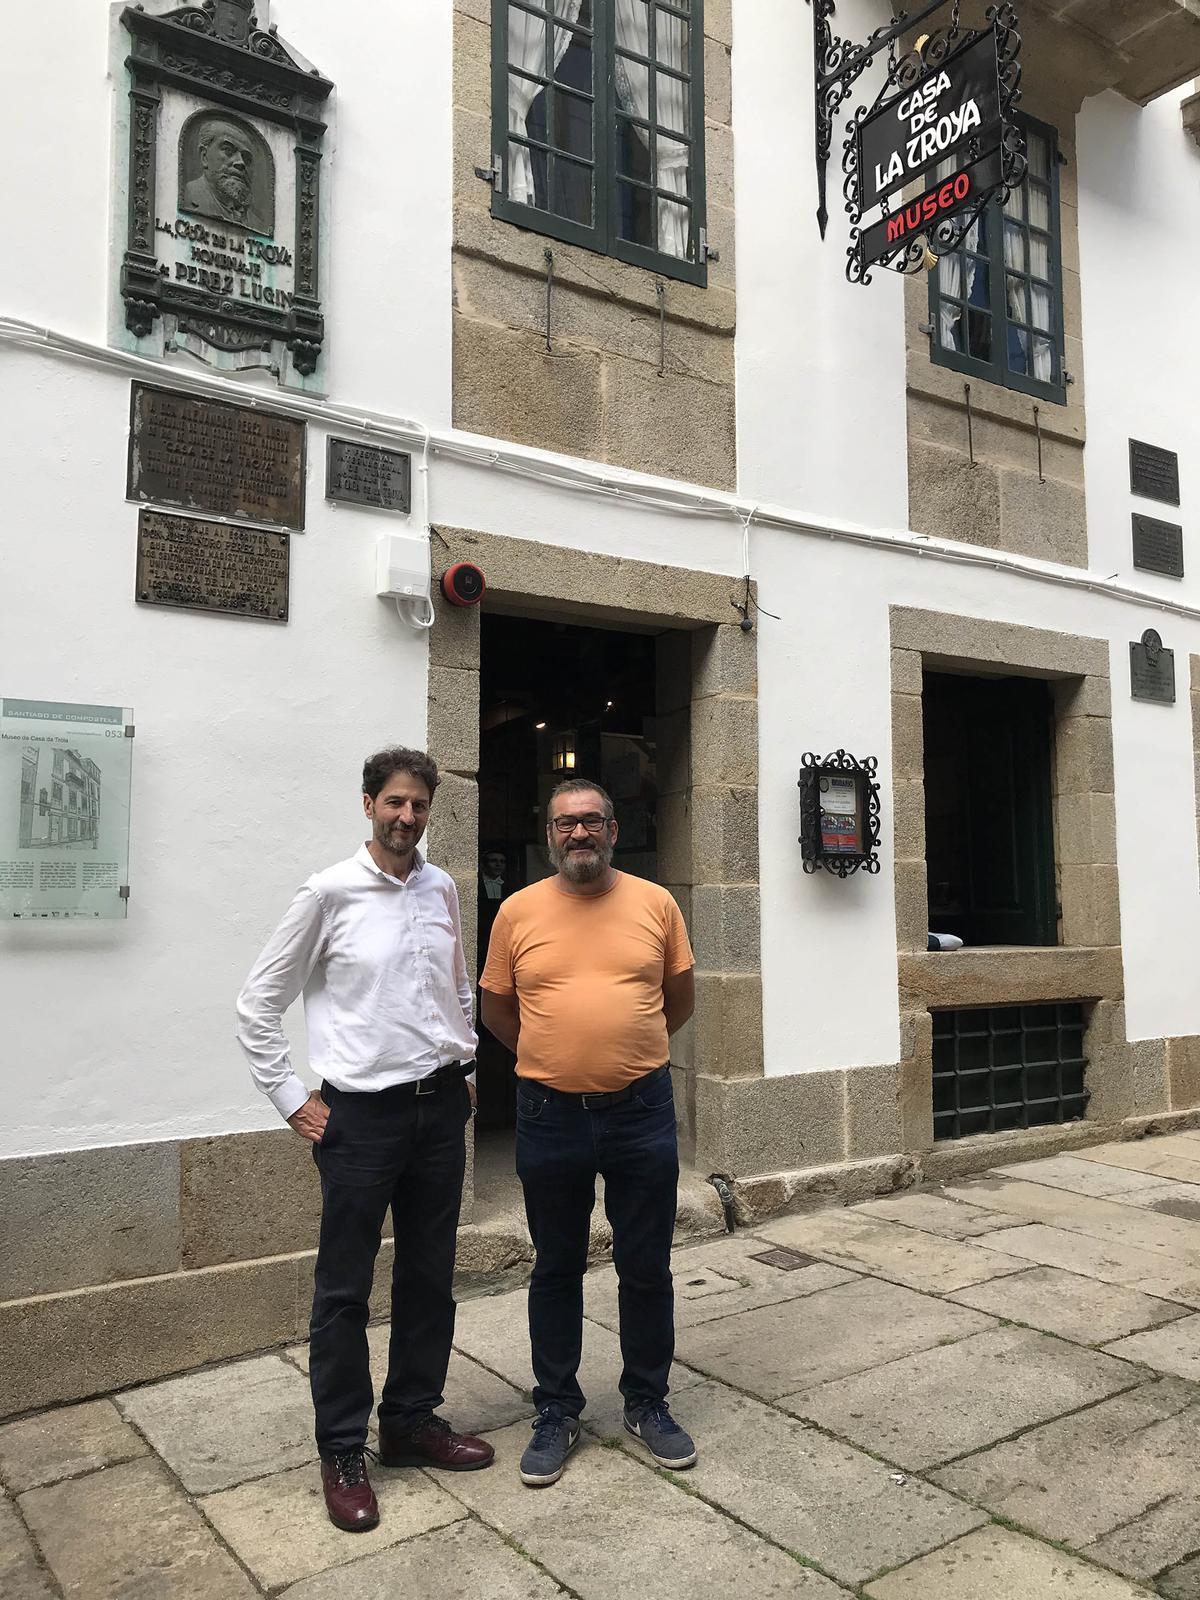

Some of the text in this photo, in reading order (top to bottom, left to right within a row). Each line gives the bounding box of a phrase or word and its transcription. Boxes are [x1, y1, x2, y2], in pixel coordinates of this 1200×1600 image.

[897, 70, 951, 121] CASA
[910, 102, 938, 134] DE
[875, 98, 981, 192] LA TROYA
[887, 173, 970, 242] MUSEO
[230, 238, 244, 254] LA
[246, 238, 292, 266] TROYA
[175, 262, 233, 295] PEREZ
[200, 447, 215, 460] DE
[219, 451, 233, 464] LA
[213, 527, 223, 537] AL
[173, 572, 199, 584] CASA
[8, 711, 50, 720] SANTIAGO
[66, 715, 118, 723] COMPOSTELA
[104, 730, 122, 738] 053
